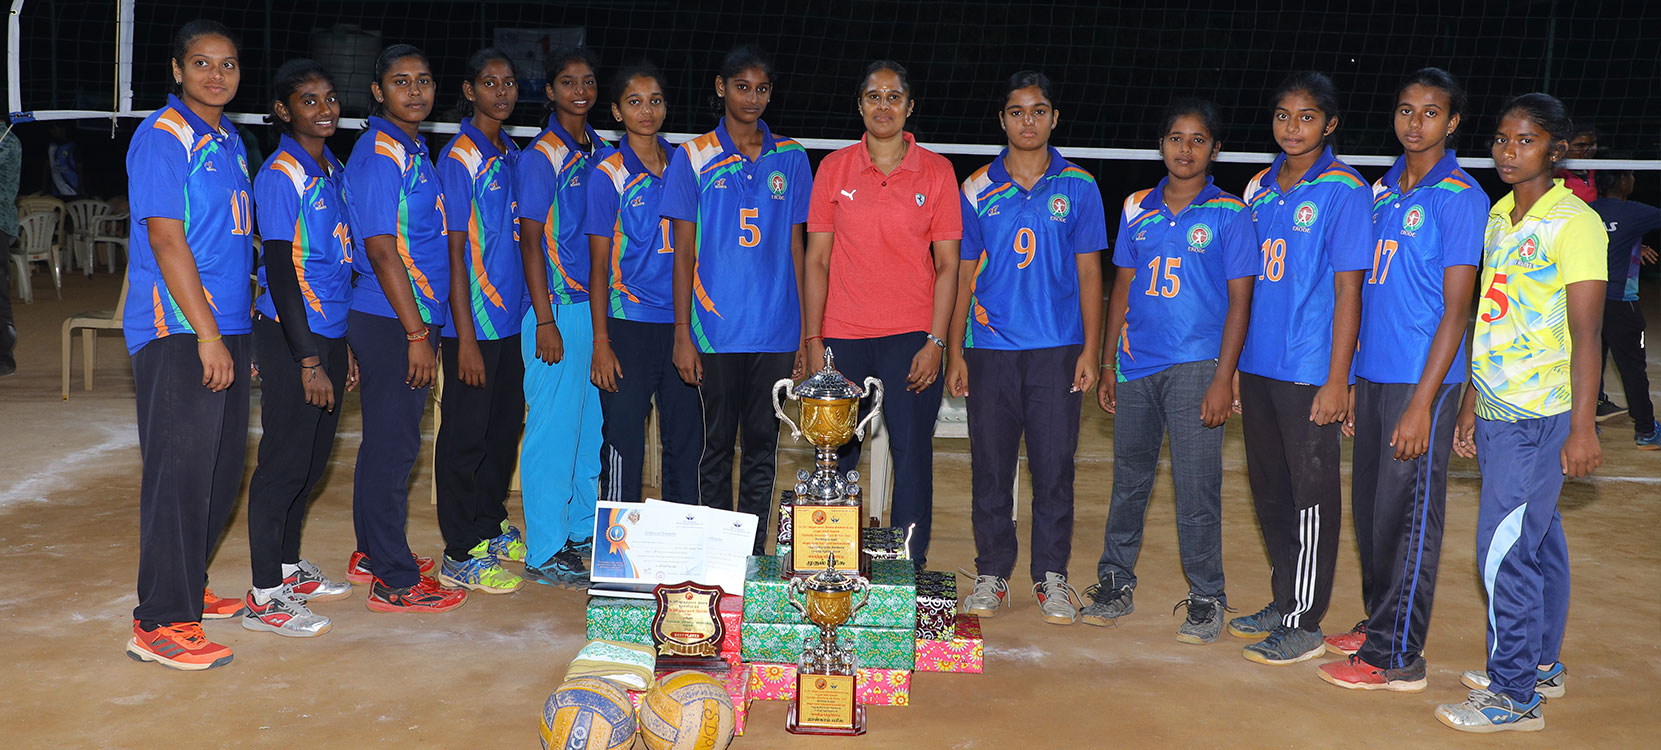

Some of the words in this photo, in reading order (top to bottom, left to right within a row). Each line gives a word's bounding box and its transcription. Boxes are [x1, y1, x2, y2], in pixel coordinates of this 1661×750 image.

[230, 190, 251, 236] 10
[739, 207, 761, 247] 5
[1292, 225, 1312, 234] ERODE
[1400, 229, 1417, 238] ERODE
[333, 222, 353, 264] 16
[1013, 227, 1036, 269] 9
[1187, 246, 1206, 255] ERODE
[1259, 238, 1287, 282] 18
[1368, 239, 1399, 285] 17
[1145, 255, 1182, 298] 15
[1481, 272, 1509, 323] 5
